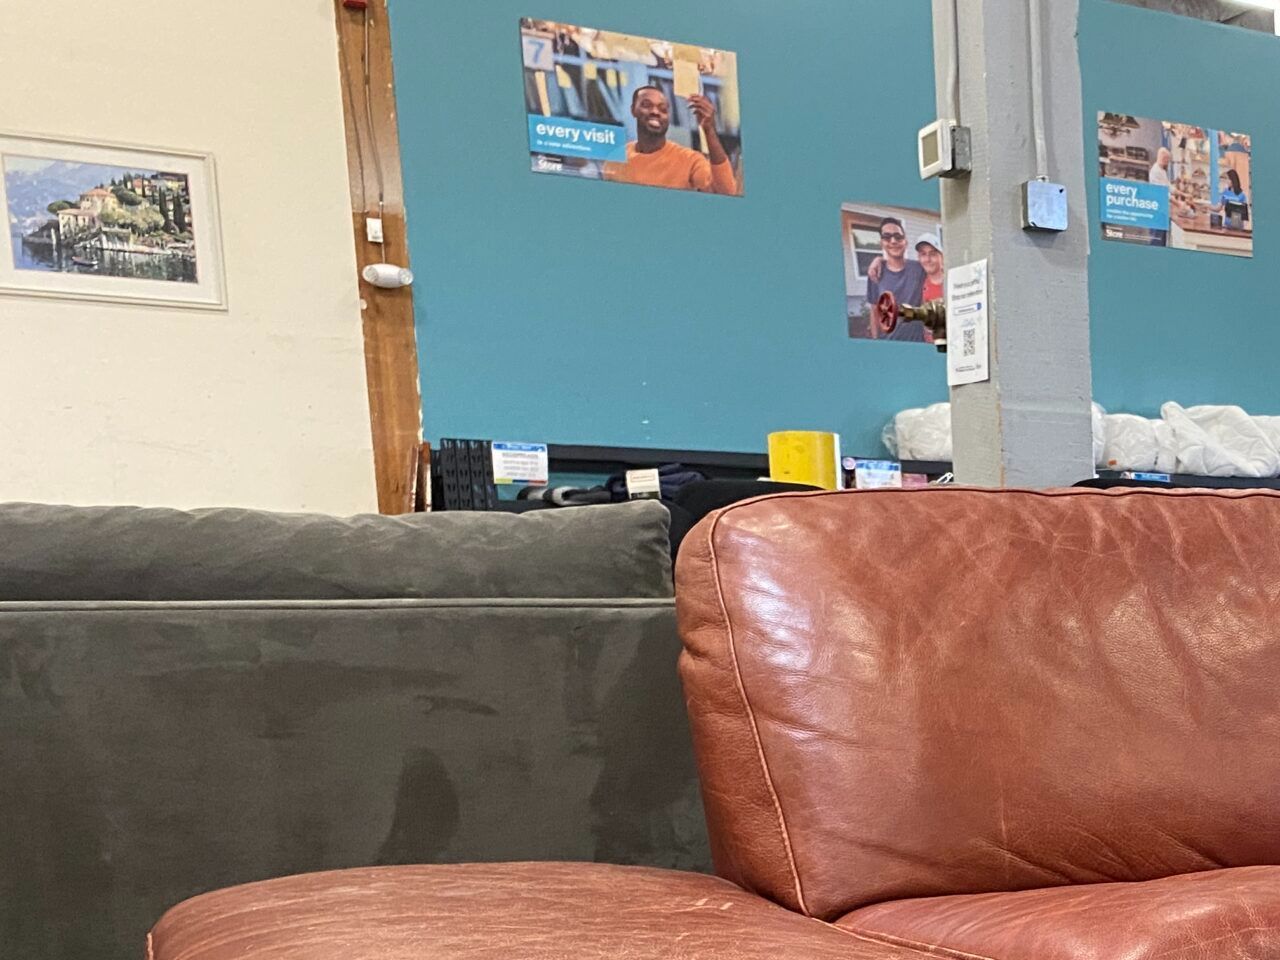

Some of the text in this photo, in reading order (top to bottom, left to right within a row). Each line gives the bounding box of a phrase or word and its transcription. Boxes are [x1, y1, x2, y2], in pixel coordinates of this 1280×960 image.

[536, 123, 616, 145] every visit
[1106, 184, 1137, 198] every
[1106, 195, 1158, 210] purchase
